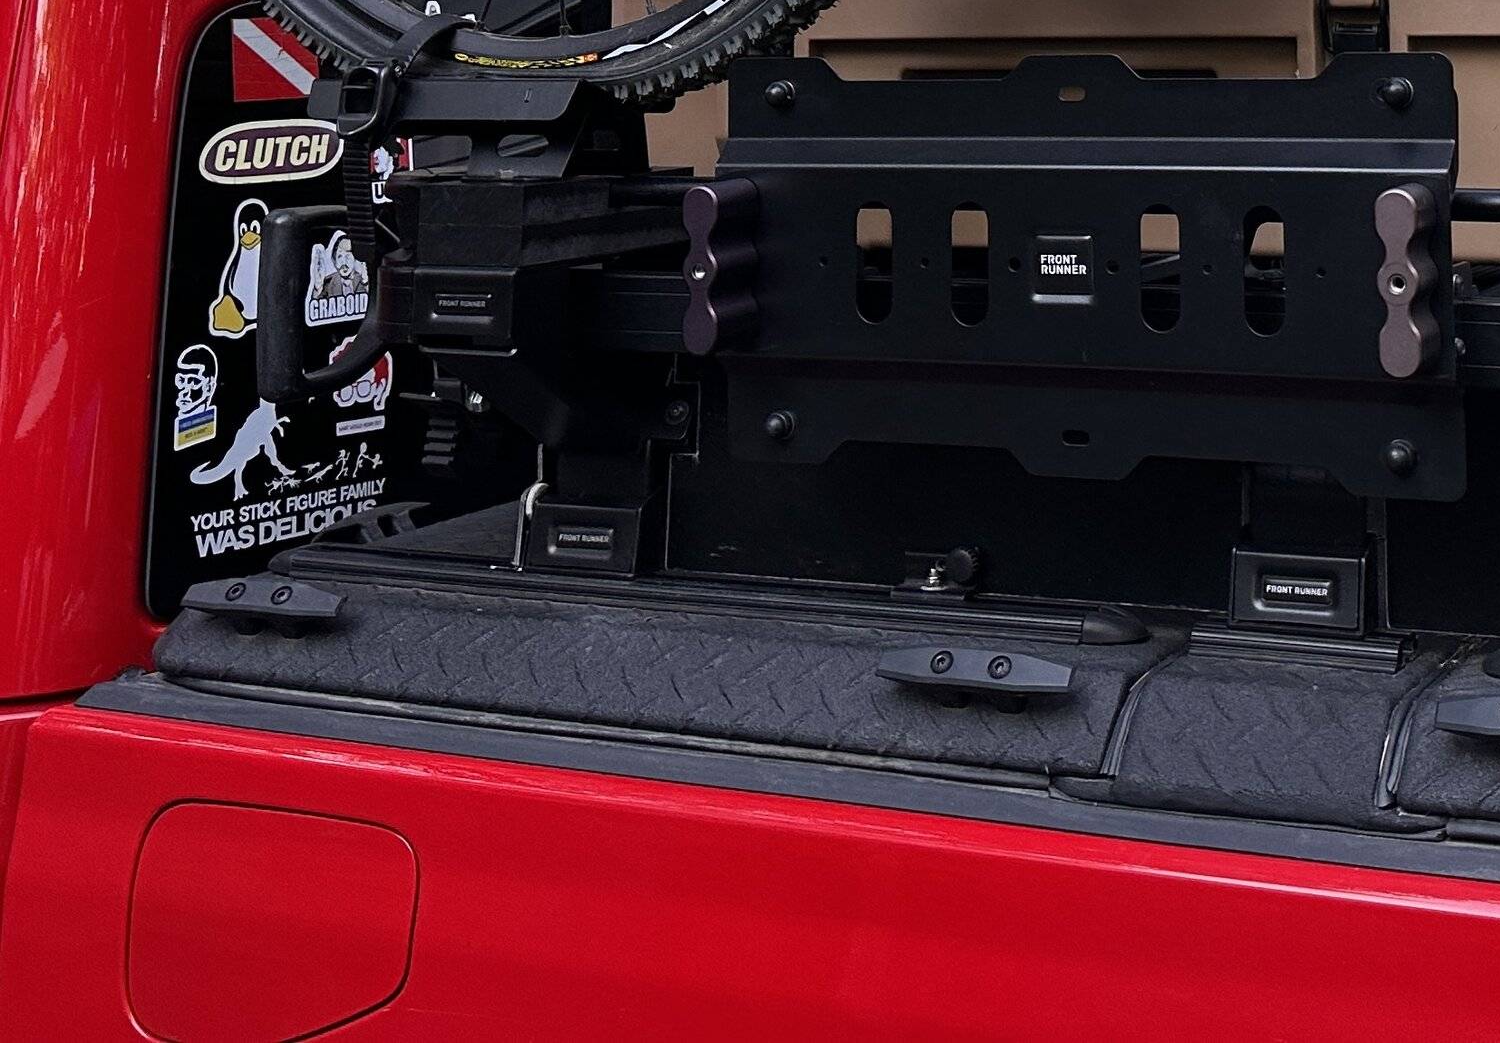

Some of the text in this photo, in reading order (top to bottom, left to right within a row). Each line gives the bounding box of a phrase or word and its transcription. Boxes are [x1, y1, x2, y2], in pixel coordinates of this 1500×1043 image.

[215, 134, 330, 172] CLUTCH
[1040, 254, 1078, 264] FRONT
[1041, 264, 1087, 275] RUNNER
[190, 477, 387, 533] YOUR STICK FIGURE FAMILY
[195, 523, 256, 558] WAS
[1266, 584, 1328, 596] FRONT RUNNER
